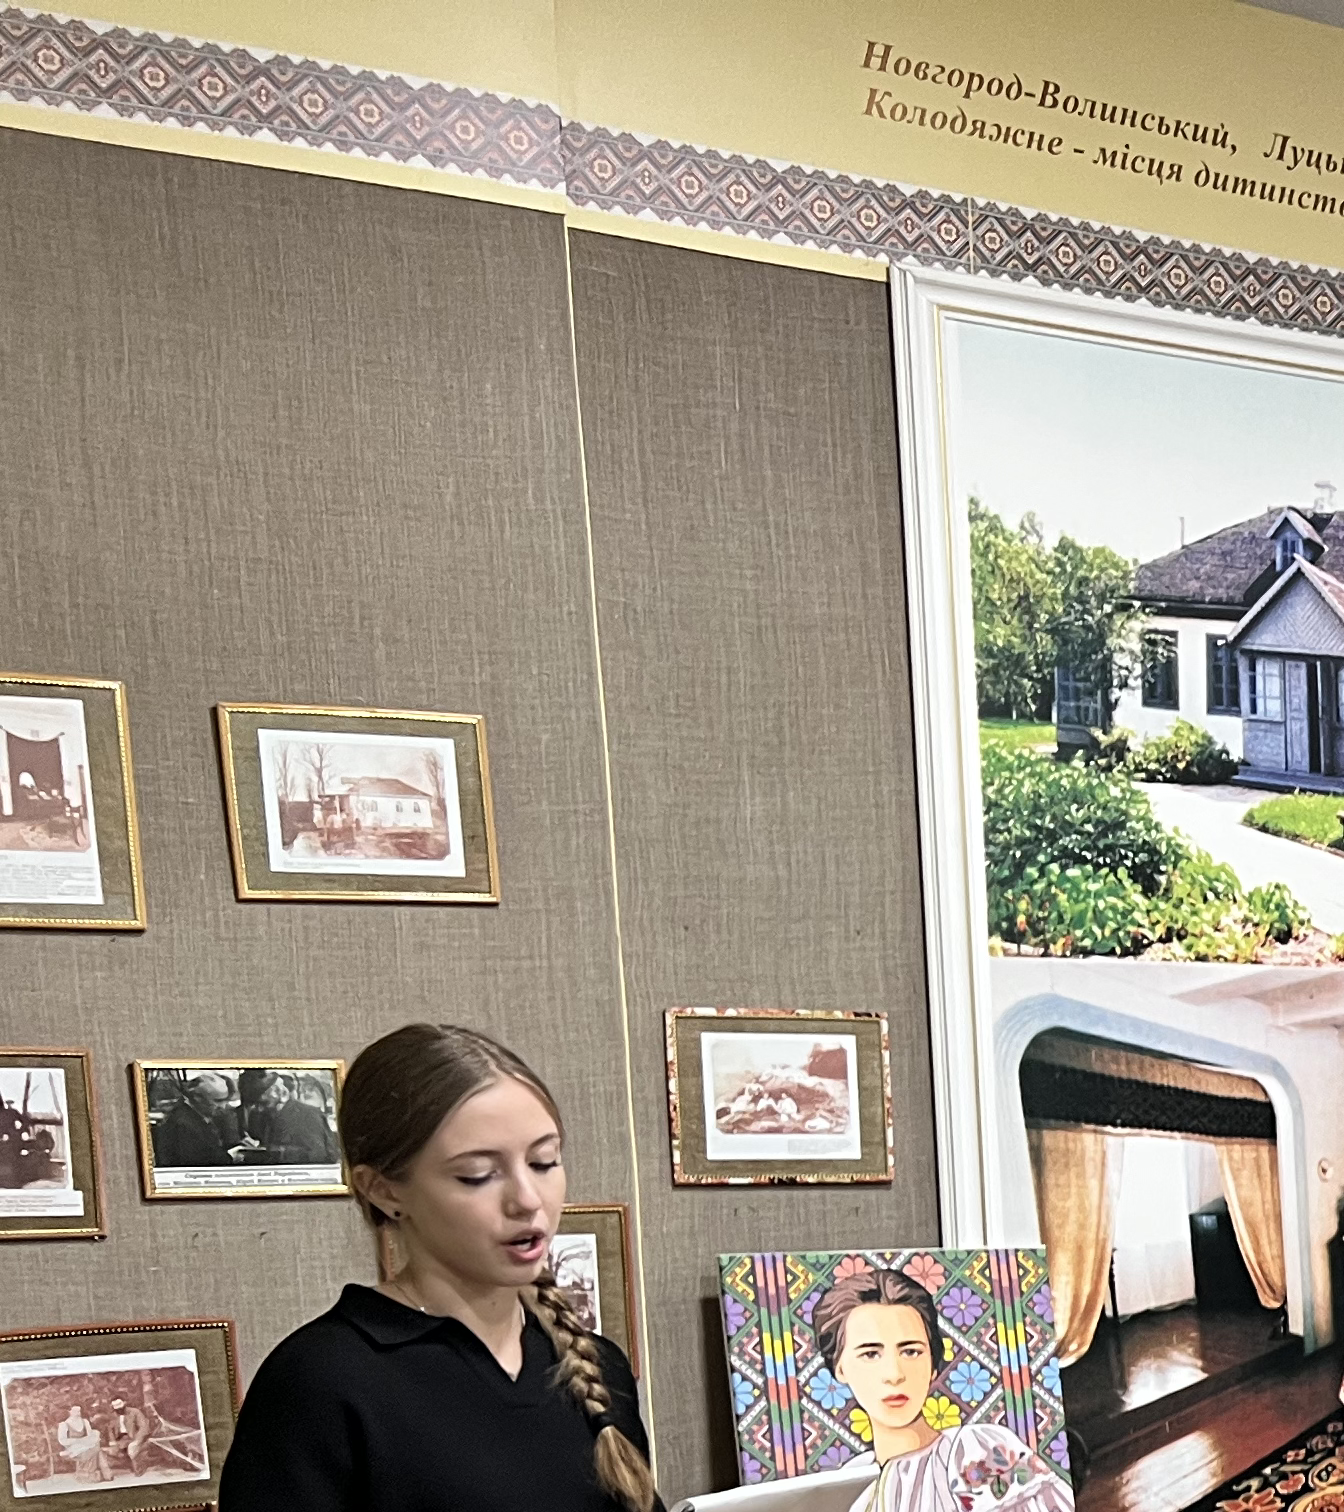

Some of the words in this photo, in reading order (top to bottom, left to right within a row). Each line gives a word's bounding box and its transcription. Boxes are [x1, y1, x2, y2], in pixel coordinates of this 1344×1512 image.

[859, 40, 1238, 156] Новгород-Волинський,
[862, 88, 1064, 157] Колодяжне
[1092, 143, 1183, 184] місця
